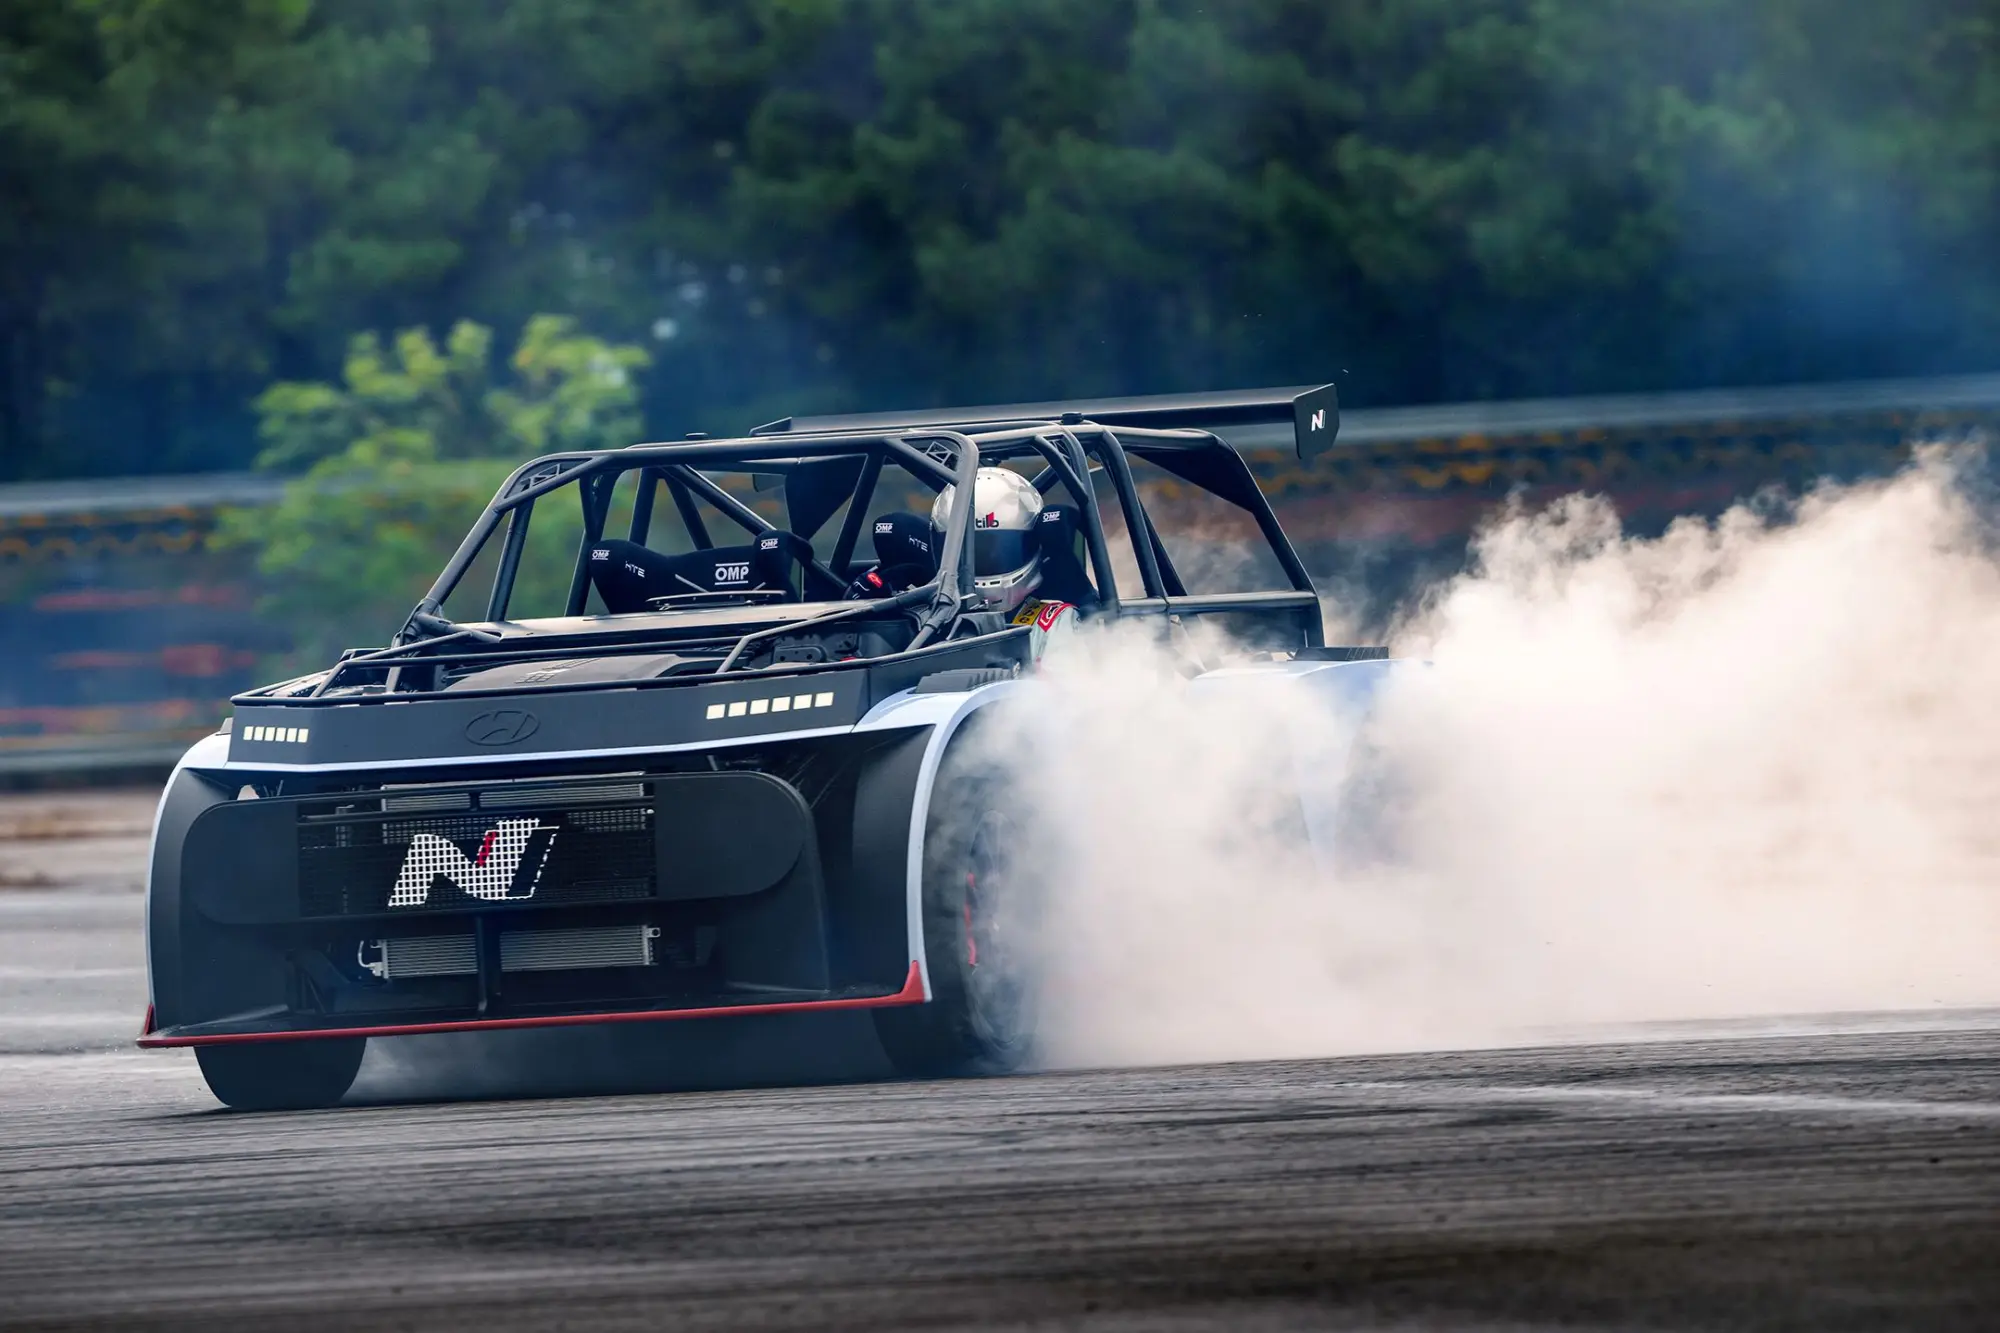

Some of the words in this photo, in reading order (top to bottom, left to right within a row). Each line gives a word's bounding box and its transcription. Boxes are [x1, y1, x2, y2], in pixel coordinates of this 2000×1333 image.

[1311, 409, 1326, 431] N
[975, 512, 999, 528] tilo
[1043, 512, 1060, 522] OMP
[875, 524, 893, 533] OMP
[761, 539, 778, 548] OMP
[592, 550, 610, 560] OMP
[714, 563, 749, 583] OMP
[388, 818, 560, 906] N
